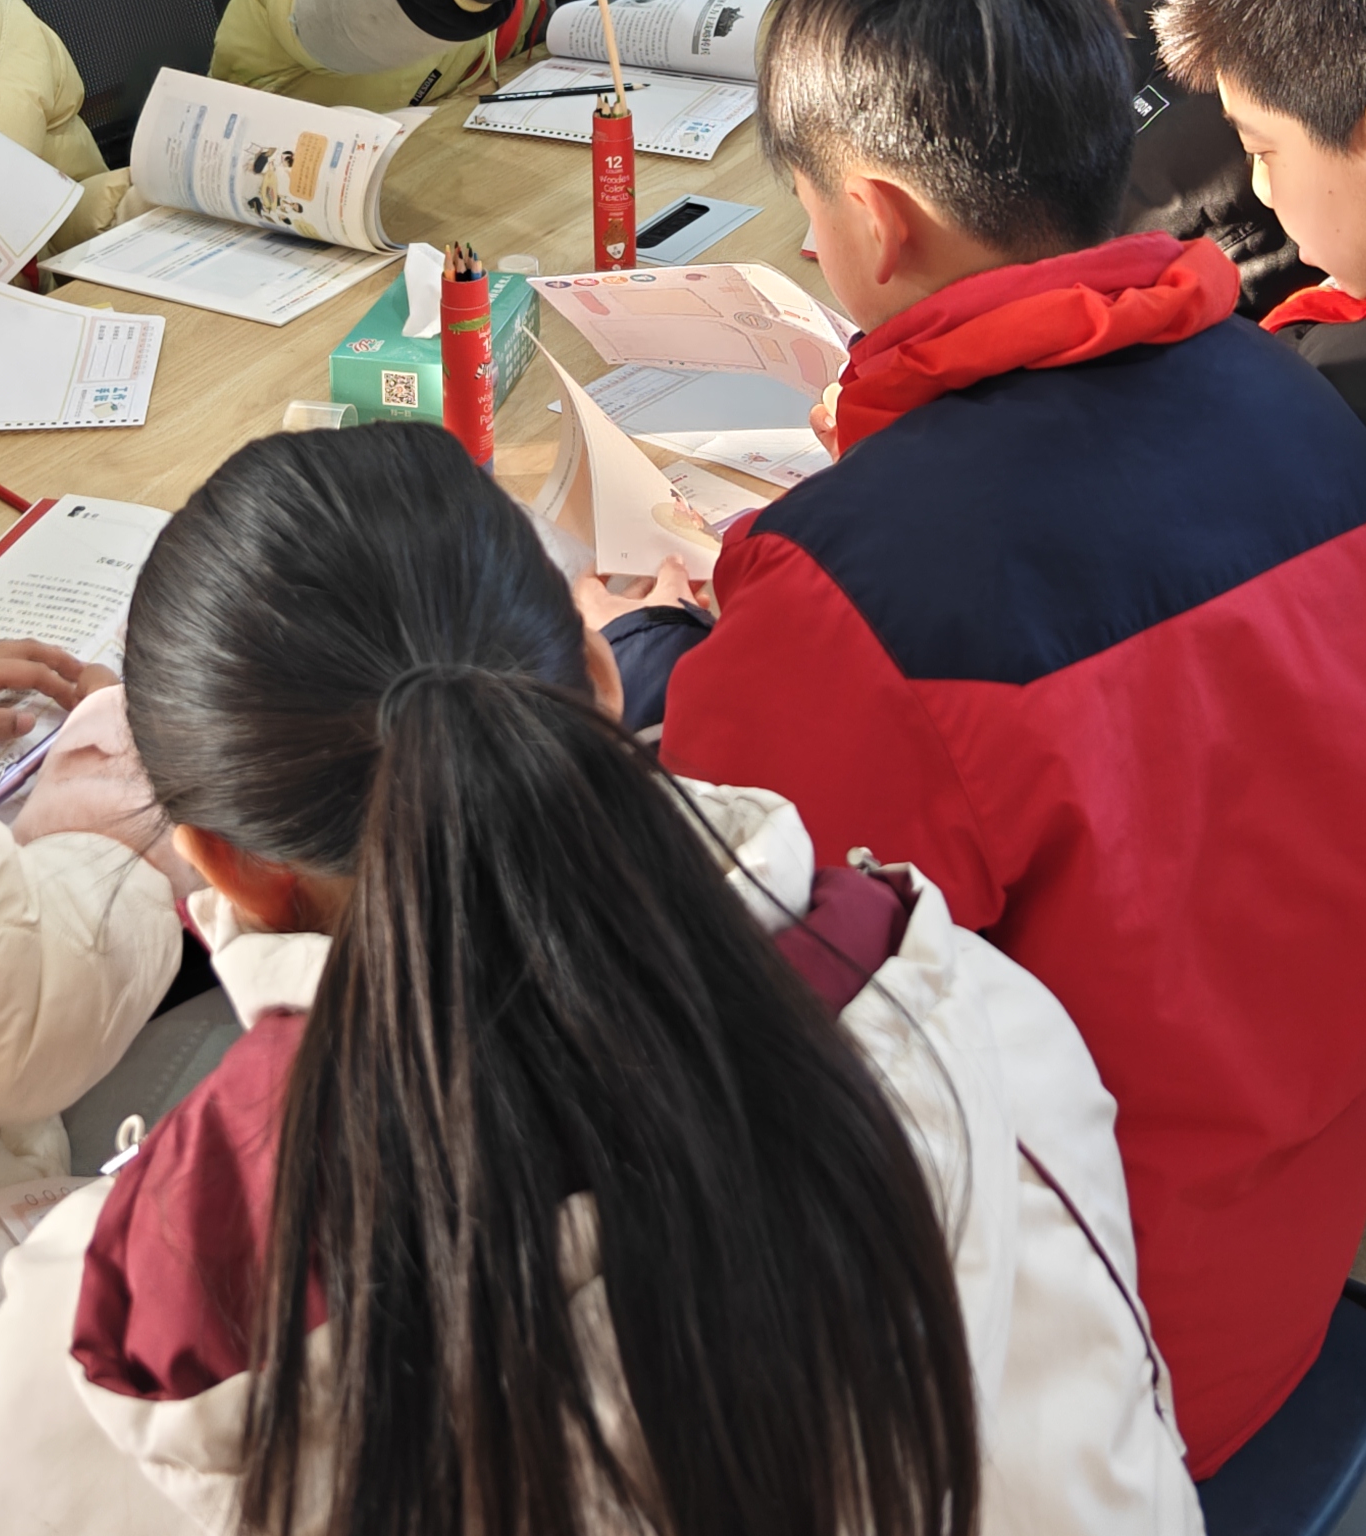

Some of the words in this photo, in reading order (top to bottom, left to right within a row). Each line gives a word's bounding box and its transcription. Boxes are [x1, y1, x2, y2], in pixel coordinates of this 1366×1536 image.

[413, 72, 437, 102] TUESDAY
[604, 155, 623, 169] 12
[603, 183, 626, 193] Color
[600, 192, 630, 202] Pencils
